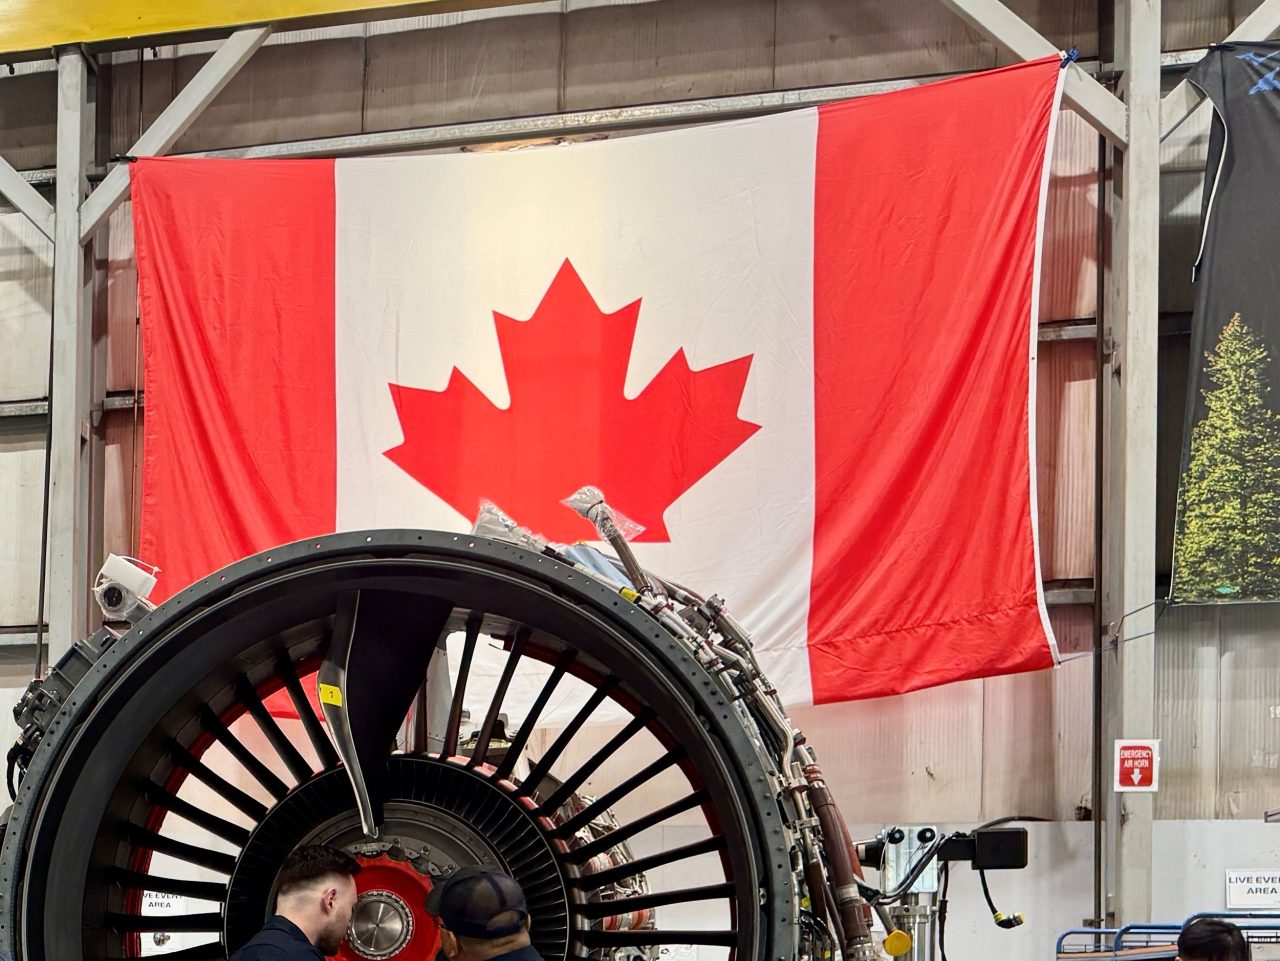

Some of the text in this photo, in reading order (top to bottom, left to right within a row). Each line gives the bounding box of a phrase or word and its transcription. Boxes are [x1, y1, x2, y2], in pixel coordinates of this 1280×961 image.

[1120, 749, 1152, 758] EMERGENCY
[1229, 876, 1280, 884] LIVE EVE
[1247, 887, 1278, 895] AREA
